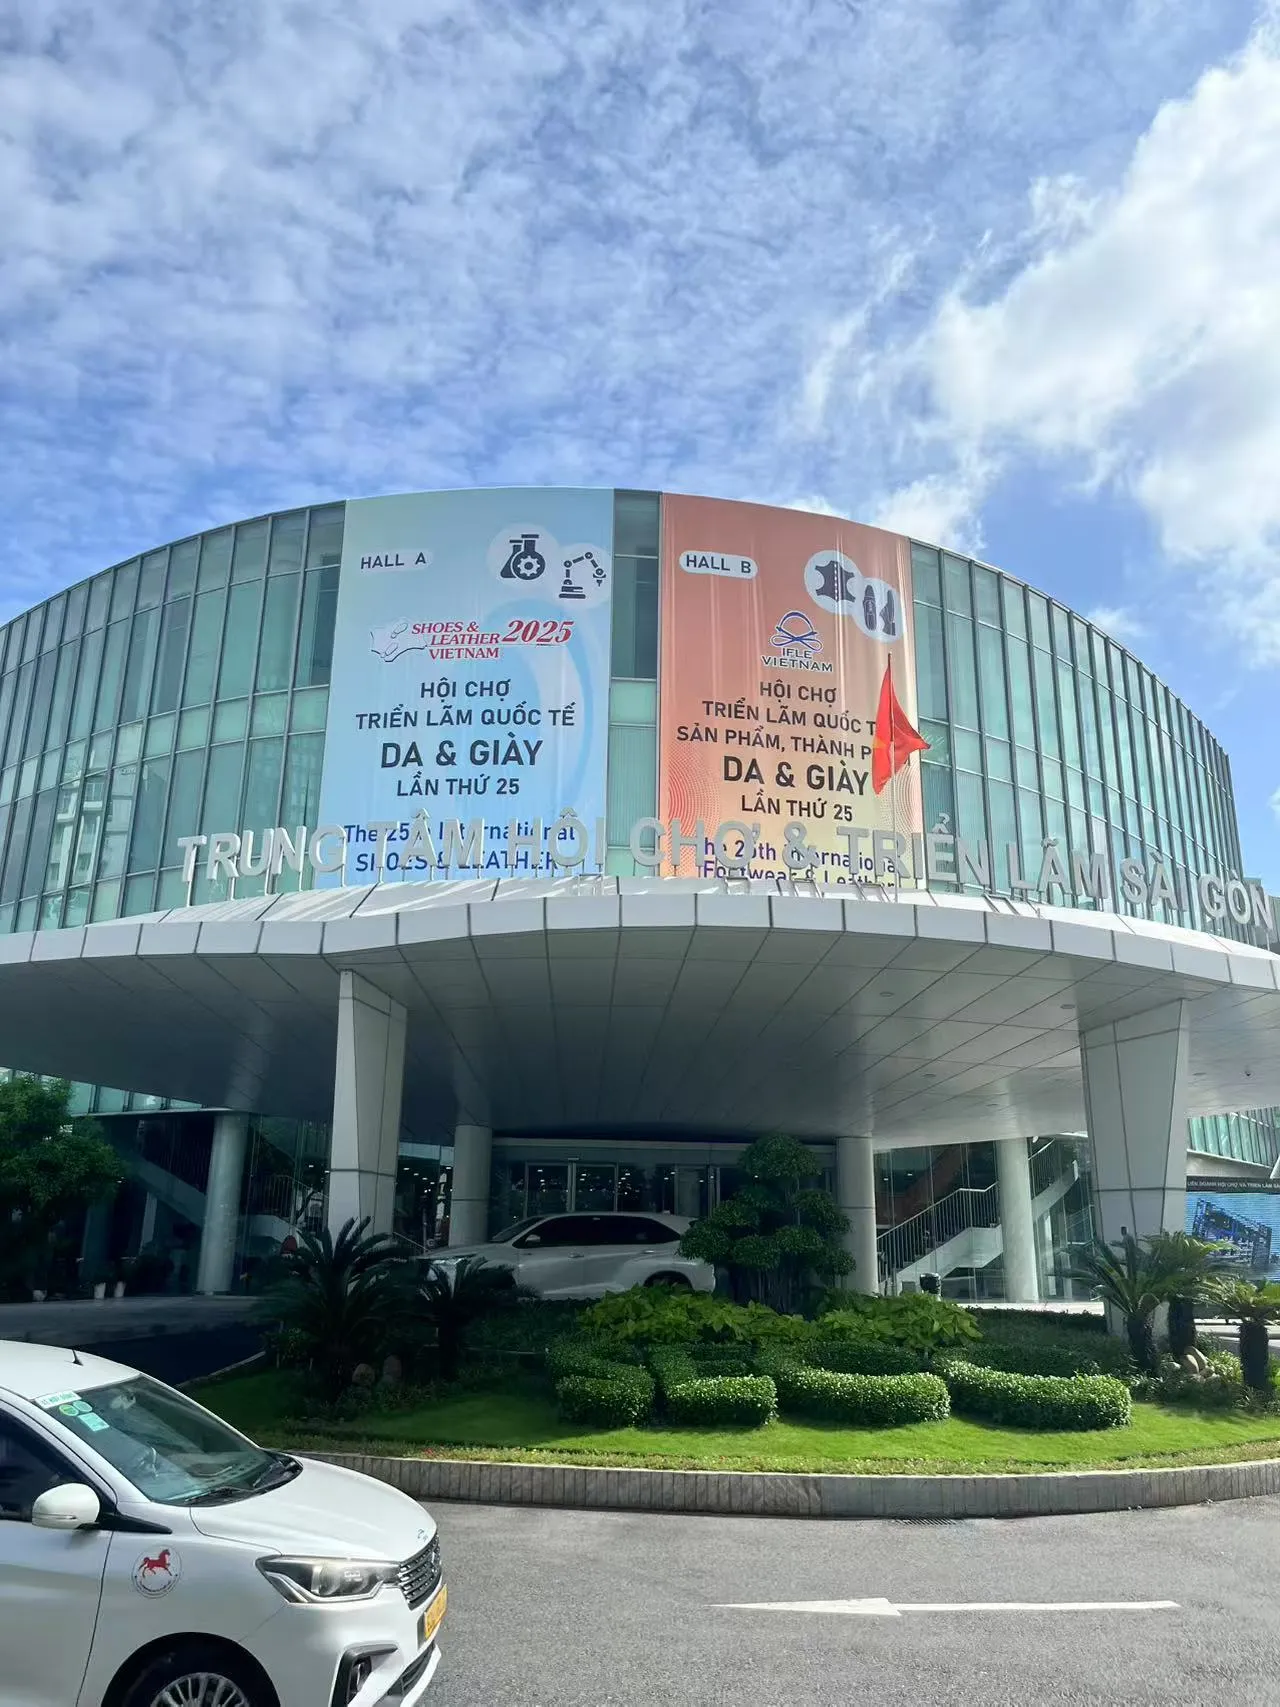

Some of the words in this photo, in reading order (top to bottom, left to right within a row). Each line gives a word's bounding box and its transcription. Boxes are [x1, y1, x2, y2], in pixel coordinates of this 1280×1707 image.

[361, 553, 404, 569] HALL
[415, 552, 427, 565] A
[686, 554, 730, 572] HALL
[741, 561, 752, 574] B
[411, 622, 463, 635] SHOES
[467, 622, 479, 633] &
[431, 633, 500, 646] LEATHER
[501, 620, 575, 643] 2025
[429, 647, 499, 660] VIETNAM
[762, 655, 833, 672] VIETNAM
[782, 647, 812, 659] IFLE
[421, 677, 456, 702] HỘI
[465, 679, 511, 701] CHỢ
[760, 679, 791, 702] HỘI
[798, 686, 837, 708] CHỢ
[356, 704, 418, 730] TRIỂN
[426, 705, 473, 727] LÃM
[481, 701, 541, 726] QUỐC
[548, 702, 576, 727] TẾ
[702, 697, 760, 722] TRIỂN
[766, 705, 807, 727] LÃM
[813, 710, 861, 734] QUỐC
[381, 741, 423, 768] DA
[436, 740, 457, 767] &
[469, 732, 543, 766] GIÀY
[677, 723, 718, 742] SẢN
[725, 726, 786, 753] PHẨM,
[791, 733, 854, 758] THÀNH
[397, 770, 439, 797] LẦN
[446, 774, 490, 795] THỨ
[496, 778, 520, 795] 25
[723, 755, 764, 785] DA
[775, 761, 795, 788] &
[806, 760, 869, 796] GIÀY
[741, 788, 780, 815] LẦN
[786, 797, 827, 819] THỨ
[834, 804, 853, 822] 25
[344, 823, 378, 843] The
[735, 840, 777, 861] 2th
[177, 824, 348, 884] TRUNG
[367, 807, 485, 868] TÂM
[782, 820, 821, 870] &
[836, 812, 991, 890] TRIỂN
[1006, 836, 1109, 900] LÃM
[1120, 848, 1189, 913] SÀI
[1199, 869, 1273, 931] GÒN
